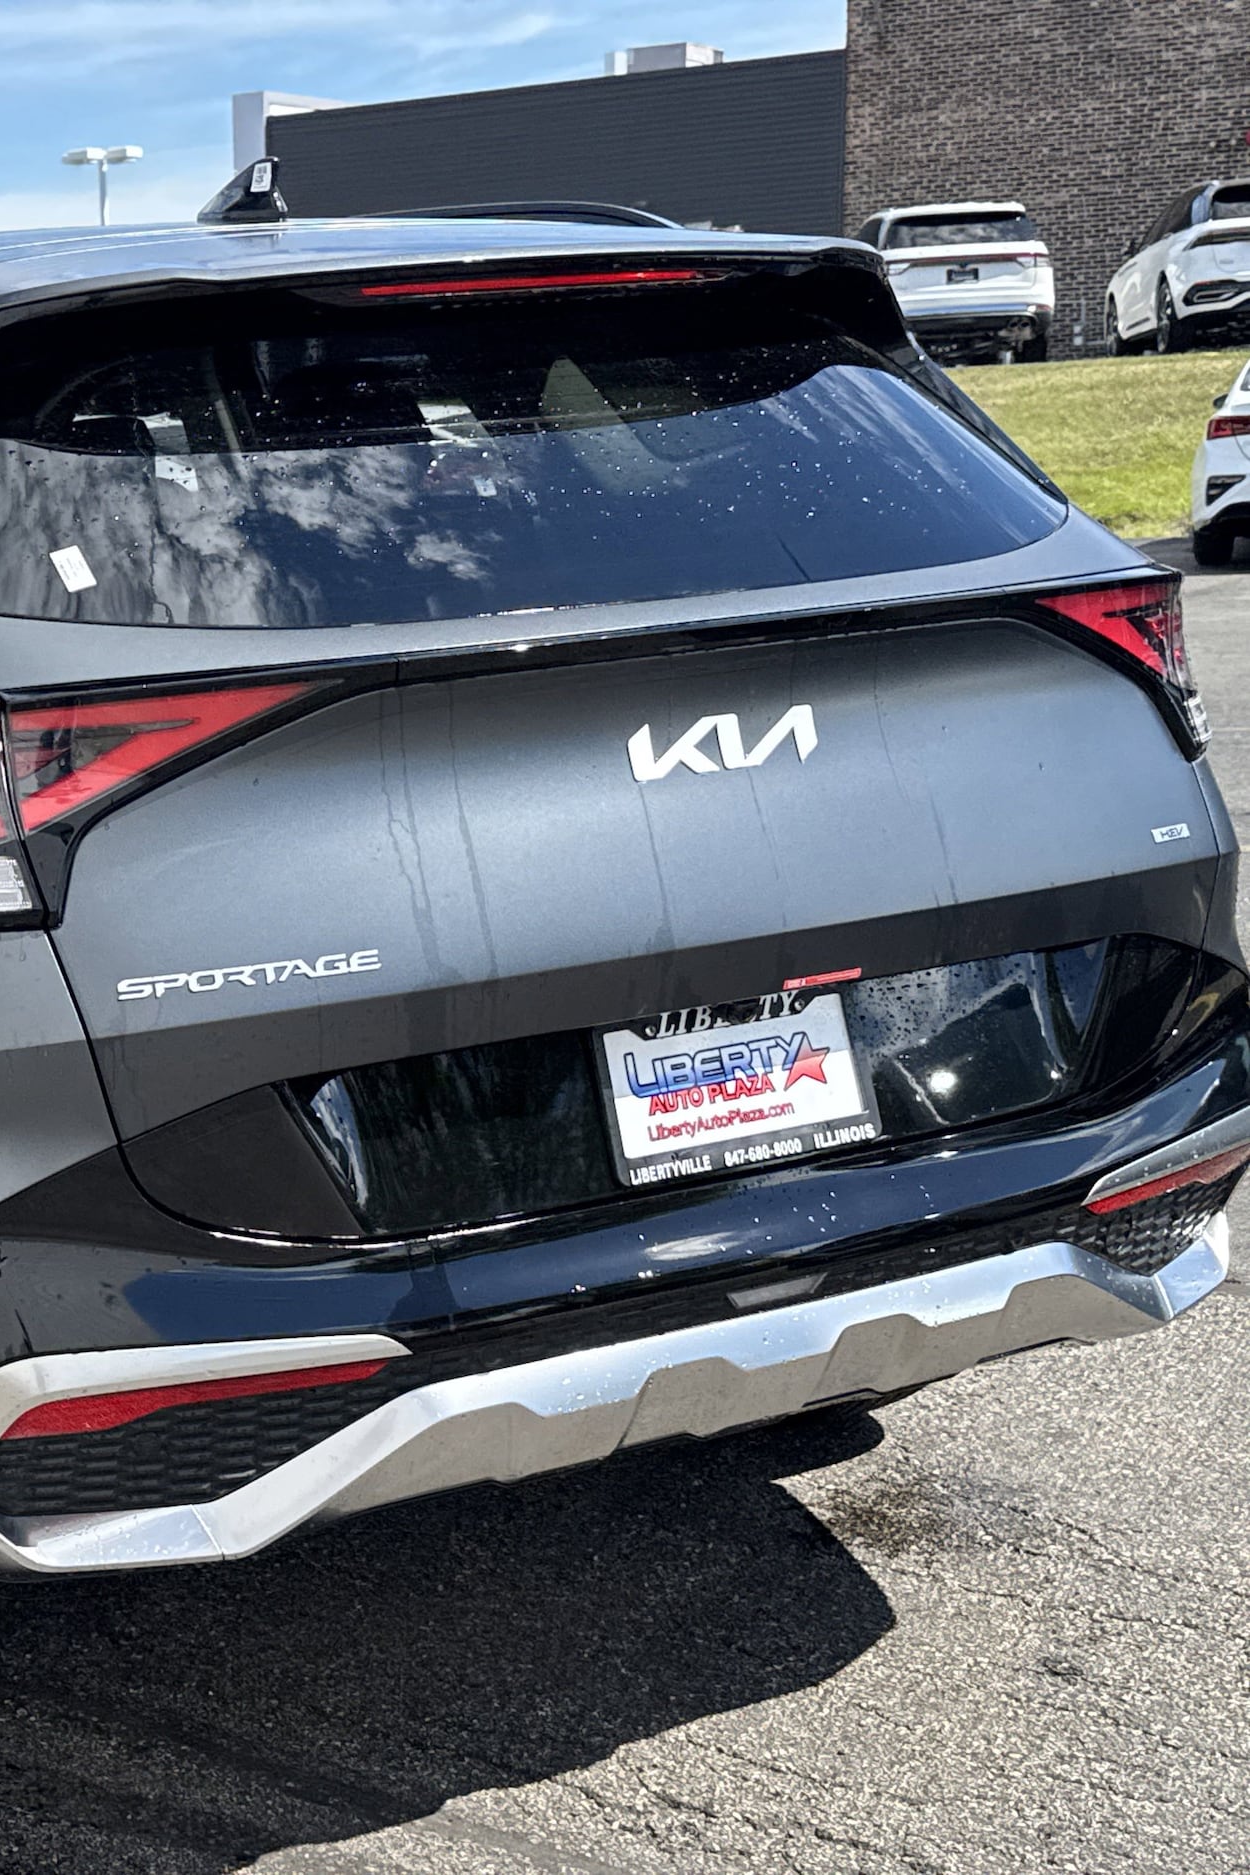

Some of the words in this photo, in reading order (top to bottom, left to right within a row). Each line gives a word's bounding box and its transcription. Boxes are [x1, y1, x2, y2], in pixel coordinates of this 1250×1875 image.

[627, 704, 819, 783] KIA
[1159, 826, 1184, 840] HEV
[117, 949, 383, 1001] SPORTAGE
[656, 990, 799, 1039] LIBTY
[624, 1031, 806, 1099] LIBERTY
[649, 1086, 704, 1116] AUTO
[708, 1073, 776, 1104] PLAZA
[647, 1102, 795, 1141] LibertyAutoPlaza.com
[630, 1155, 712, 1186] LIBERTYVILLE
[724, 1138, 802, 1167] 847-680-8000
[813, 1123, 877, 1149] ILLINOIS
